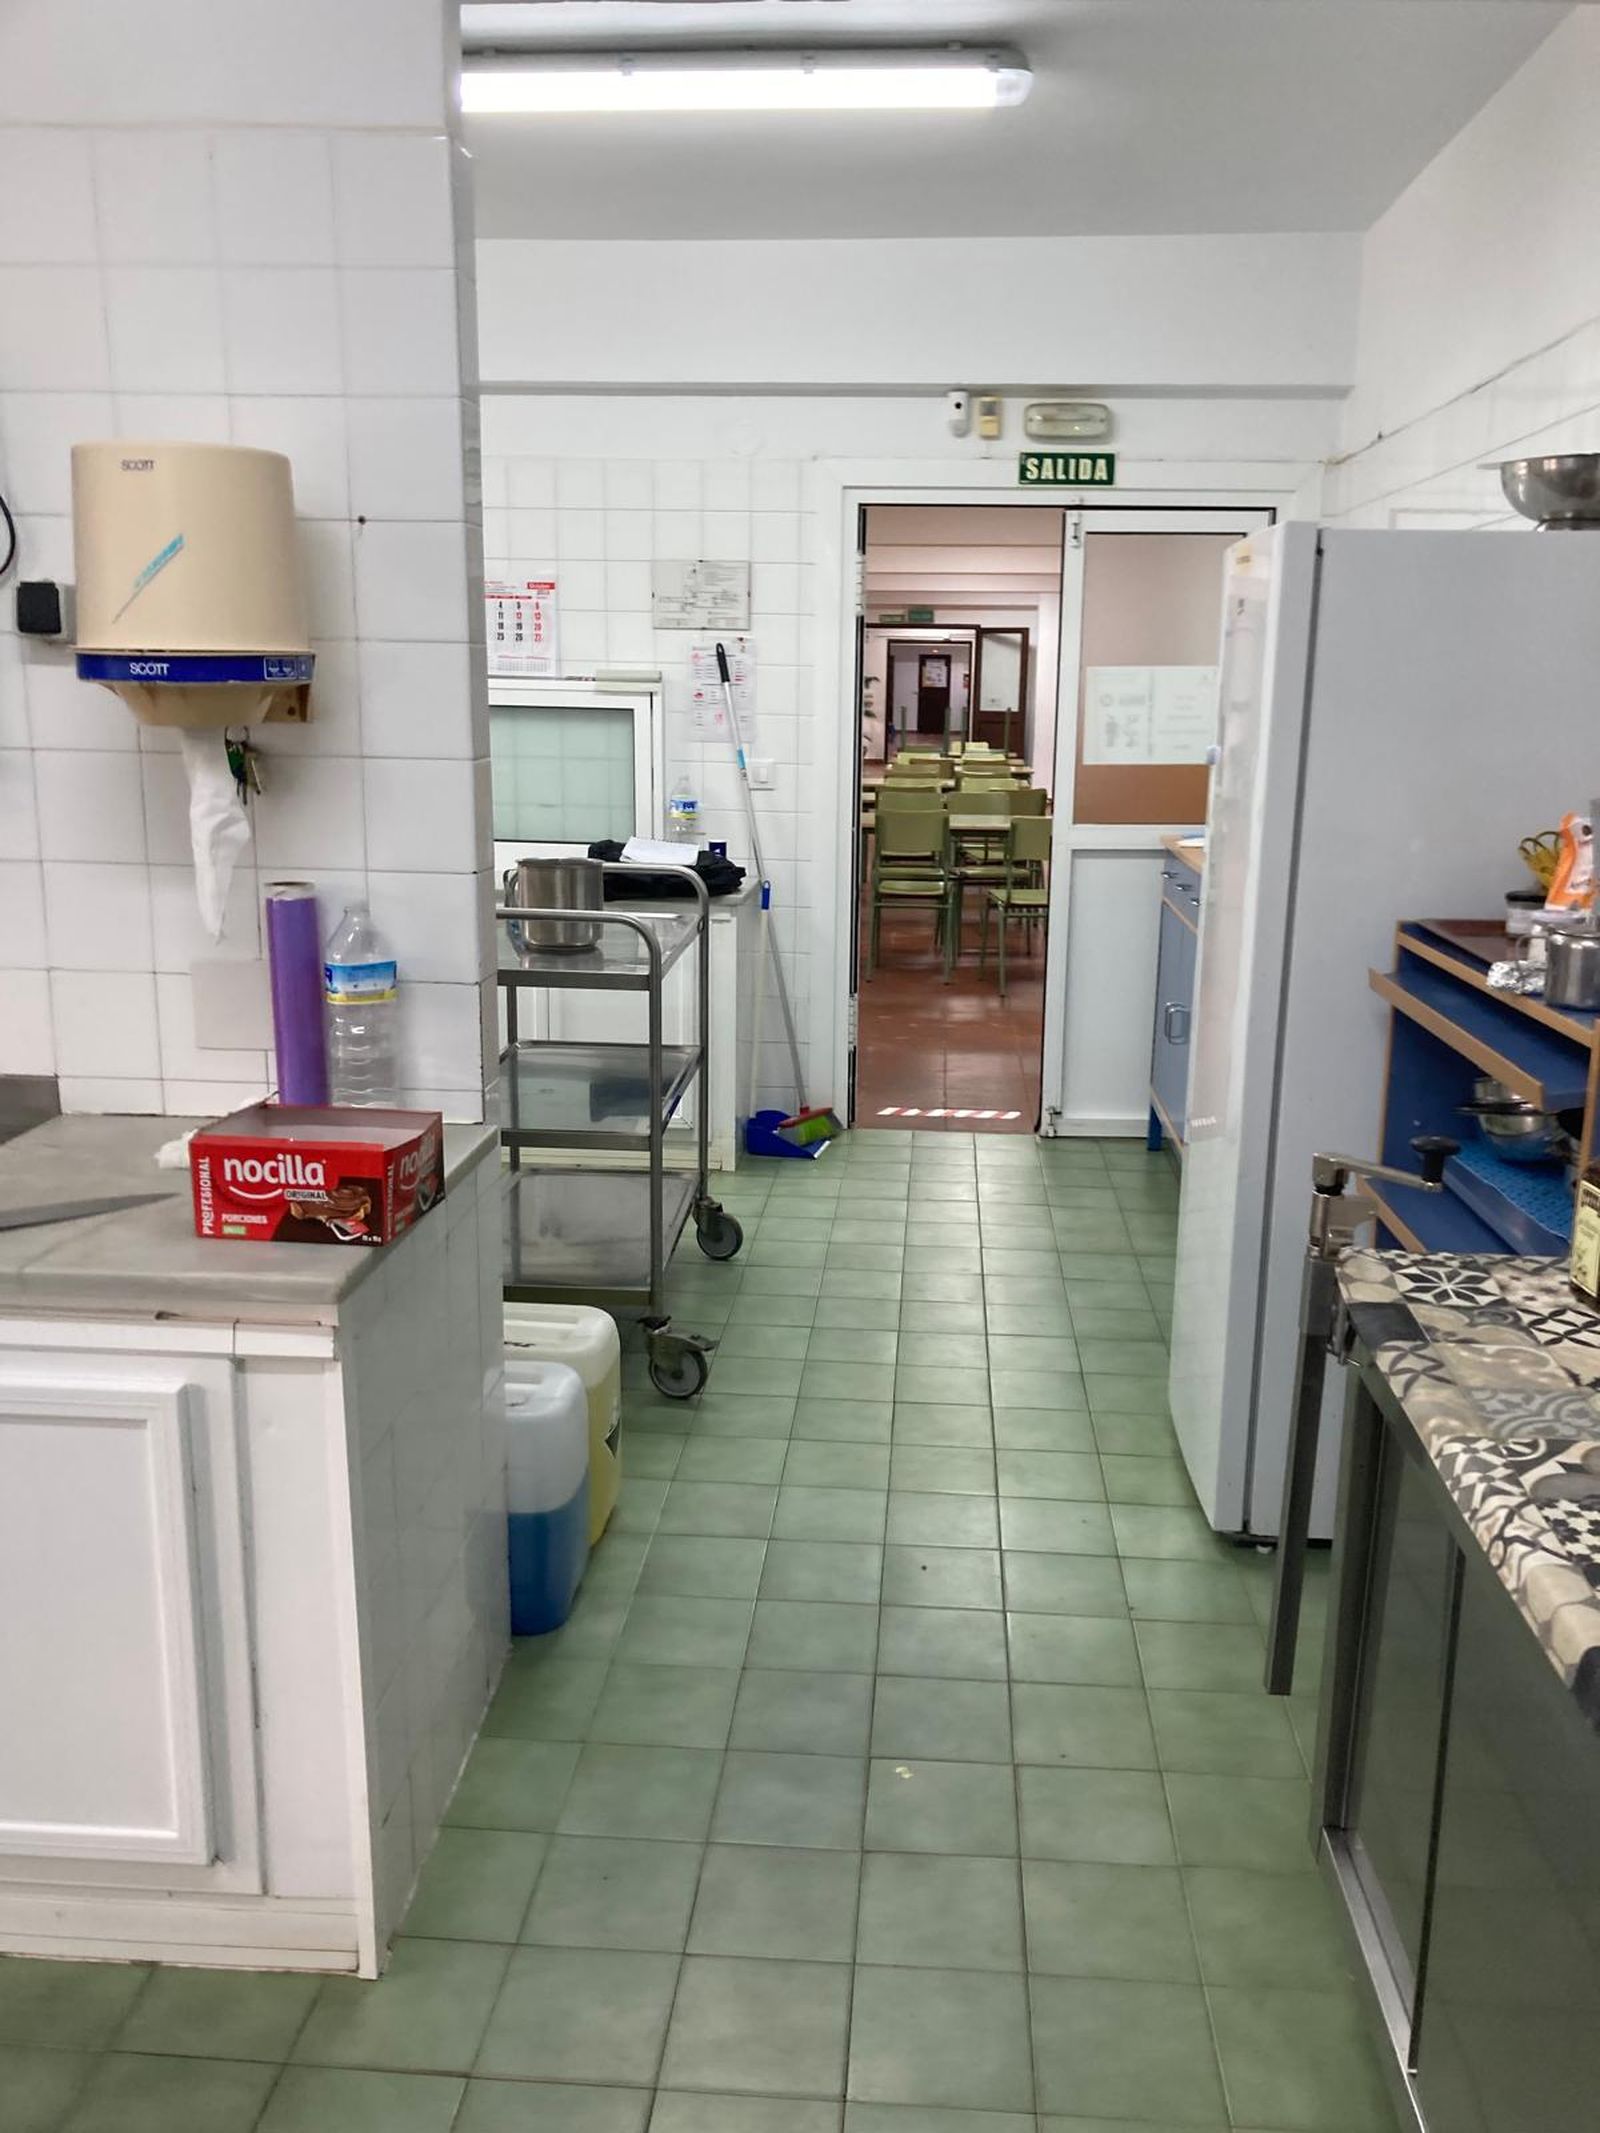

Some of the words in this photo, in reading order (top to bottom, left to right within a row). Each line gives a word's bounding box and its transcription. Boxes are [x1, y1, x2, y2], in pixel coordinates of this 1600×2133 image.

[120, 459, 155, 471] SCOTT
[1025, 457, 1109, 480] SALIDA
[129, 661, 170, 675] SCOTT
[223, 1153, 326, 1186] nocilla
[285, 1189, 327, 1200] ORIGINAL
